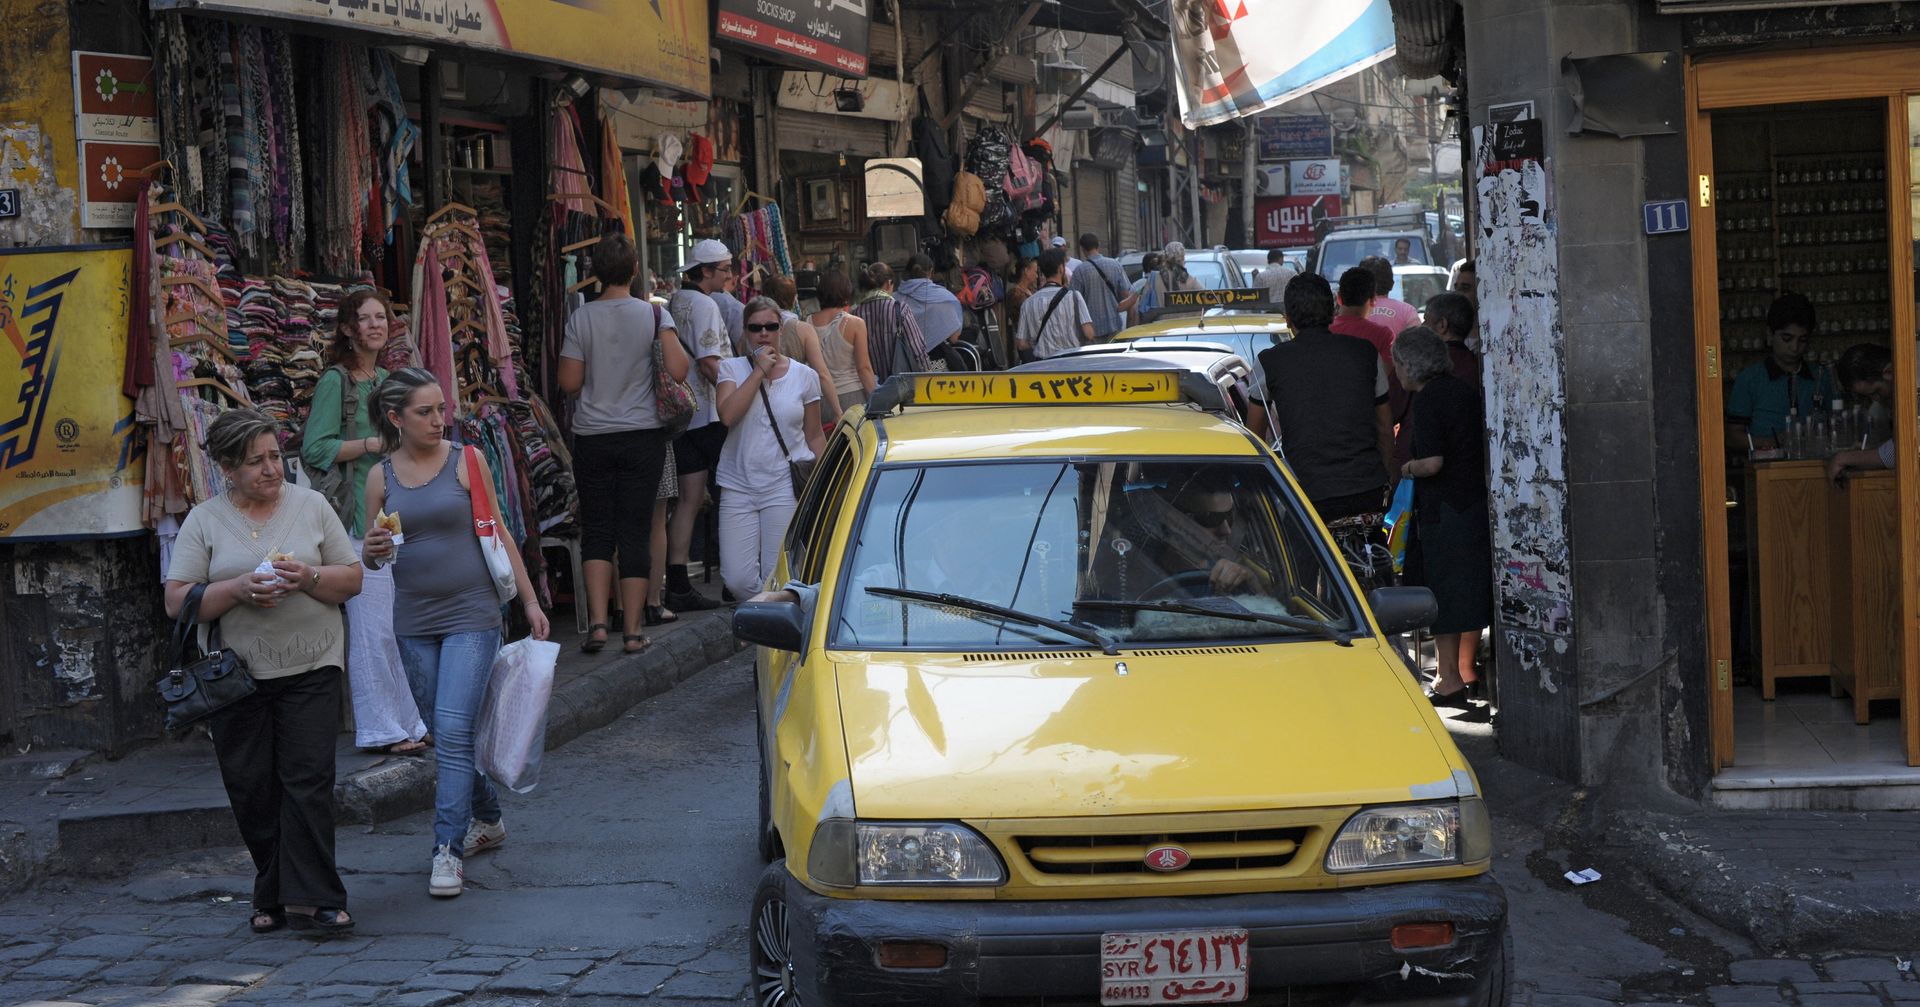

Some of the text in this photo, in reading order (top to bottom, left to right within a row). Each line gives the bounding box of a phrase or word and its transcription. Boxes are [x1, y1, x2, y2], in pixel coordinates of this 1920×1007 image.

[757, 0, 778, 20] SOCKS
[778, 8, 796, 24] SHOP
[806, 17, 841, 43] بيت الجوارب
[95, 129, 114, 137] Classical
[1652, 203, 1679, 231] 11
[1171, 293, 1193, 305] TAXI
[1144, 933, 1248, 974] ٤٦٤١٣٣
[1104, 961, 1140, 977] SYR
[1105, 984, 1150, 1000] 464133
[1163, 979, 1235, 1000] دمشق
